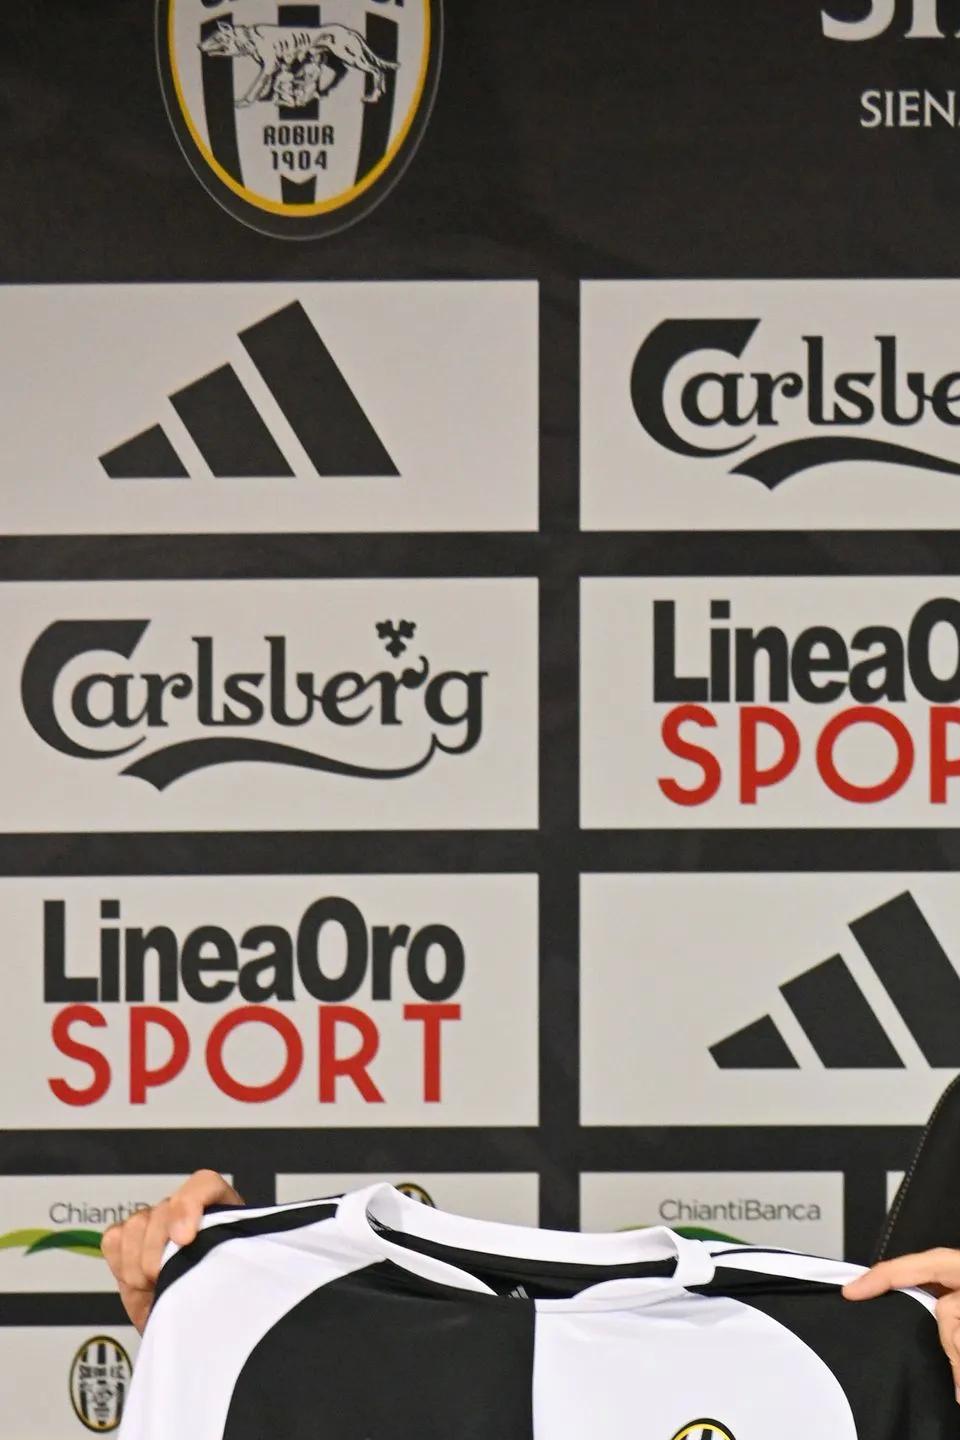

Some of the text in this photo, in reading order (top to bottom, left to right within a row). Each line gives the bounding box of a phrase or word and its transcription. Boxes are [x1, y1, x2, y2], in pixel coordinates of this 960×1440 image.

[263, 124, 335, 146] ROBUR
[271, 150, 328, 170] 1904
[20, 619, 489, 759] Carlsberg
[43, 896, 466, 1003] LineaOro
[48, 1002, 462, 1107] SPORT
[659, 1198, 821, 1222] ChiantiBanca
